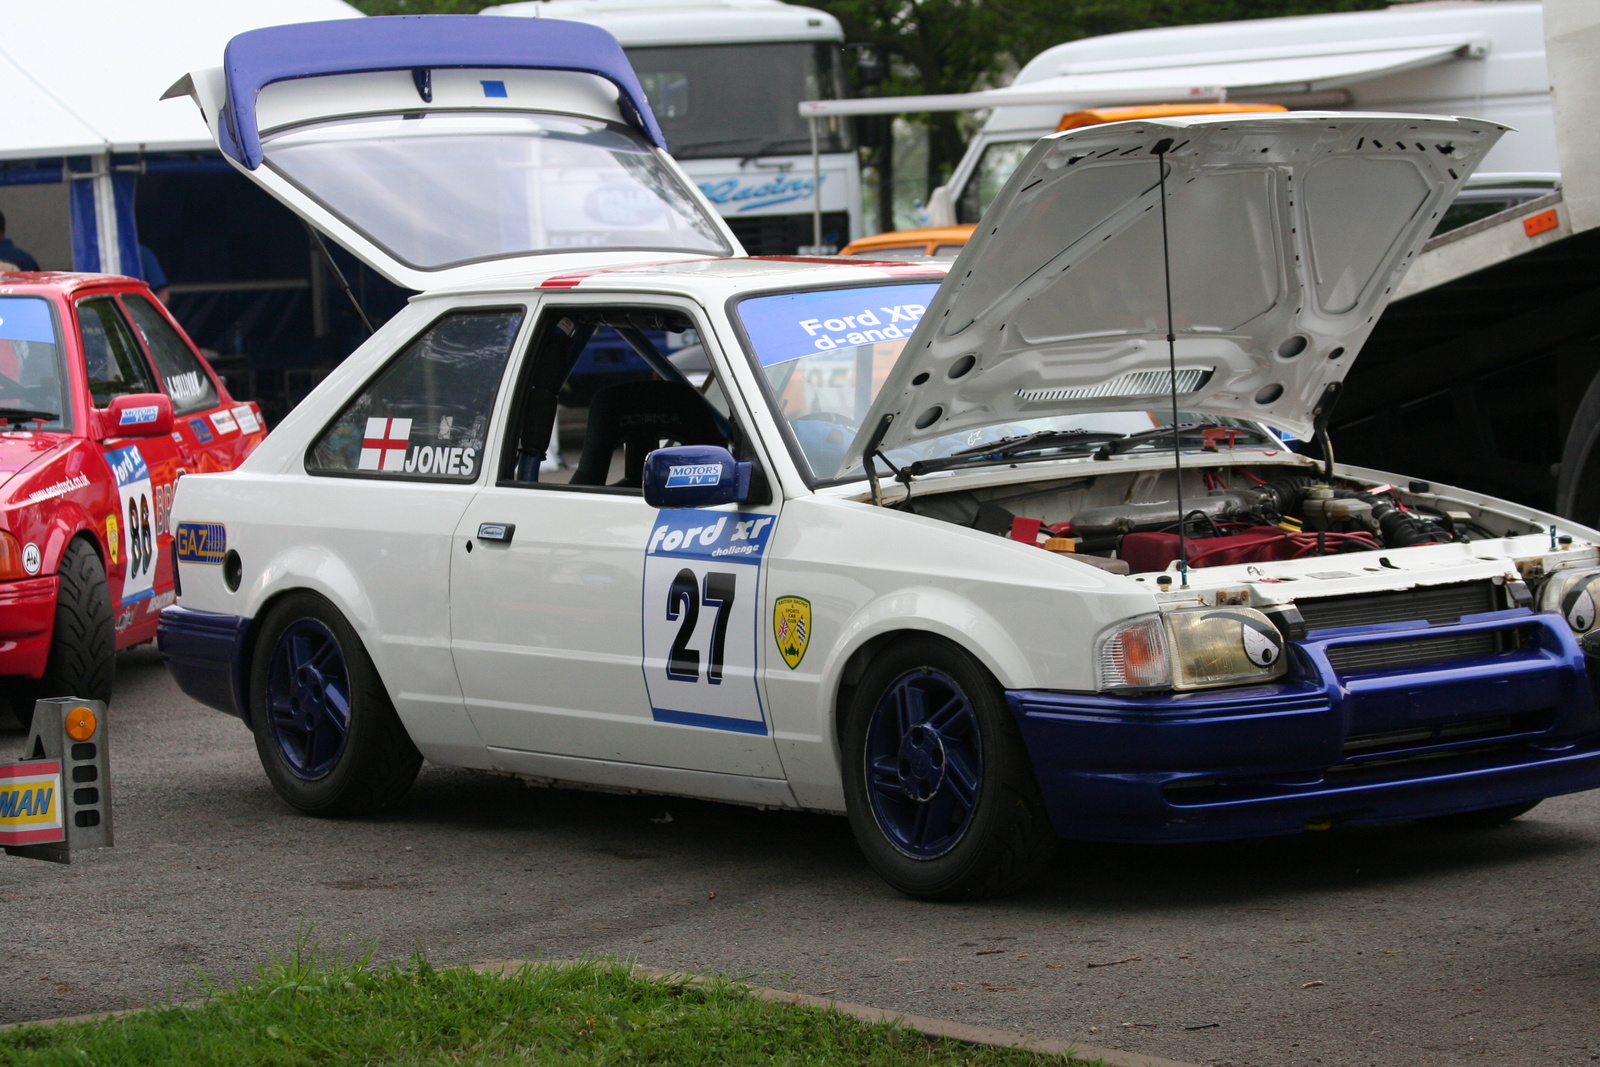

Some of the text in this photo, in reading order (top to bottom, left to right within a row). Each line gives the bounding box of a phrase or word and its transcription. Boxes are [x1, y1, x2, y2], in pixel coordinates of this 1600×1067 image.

[799, 310, 881, 336] Ford
[813, 323, 917, 350] d-and-
[124, 407, 156, 417] MOTORS
[136, 414, 145, 422] TV
[111, 450, 134, 487] ford
[404, 445, 475, 475] JONES
[672, 465, 719, 476] MOTORS
[688, 475, 704, 485] TV
[178, 528, 226, 557] GAZ
[647, 516, 772, 554] ford xr
[711, 543, 760, 558] challenge
[793, 599, 808, 608] RACING
[666, 567, 737, 685] 27
[0, 788, 53, 818] MAN
